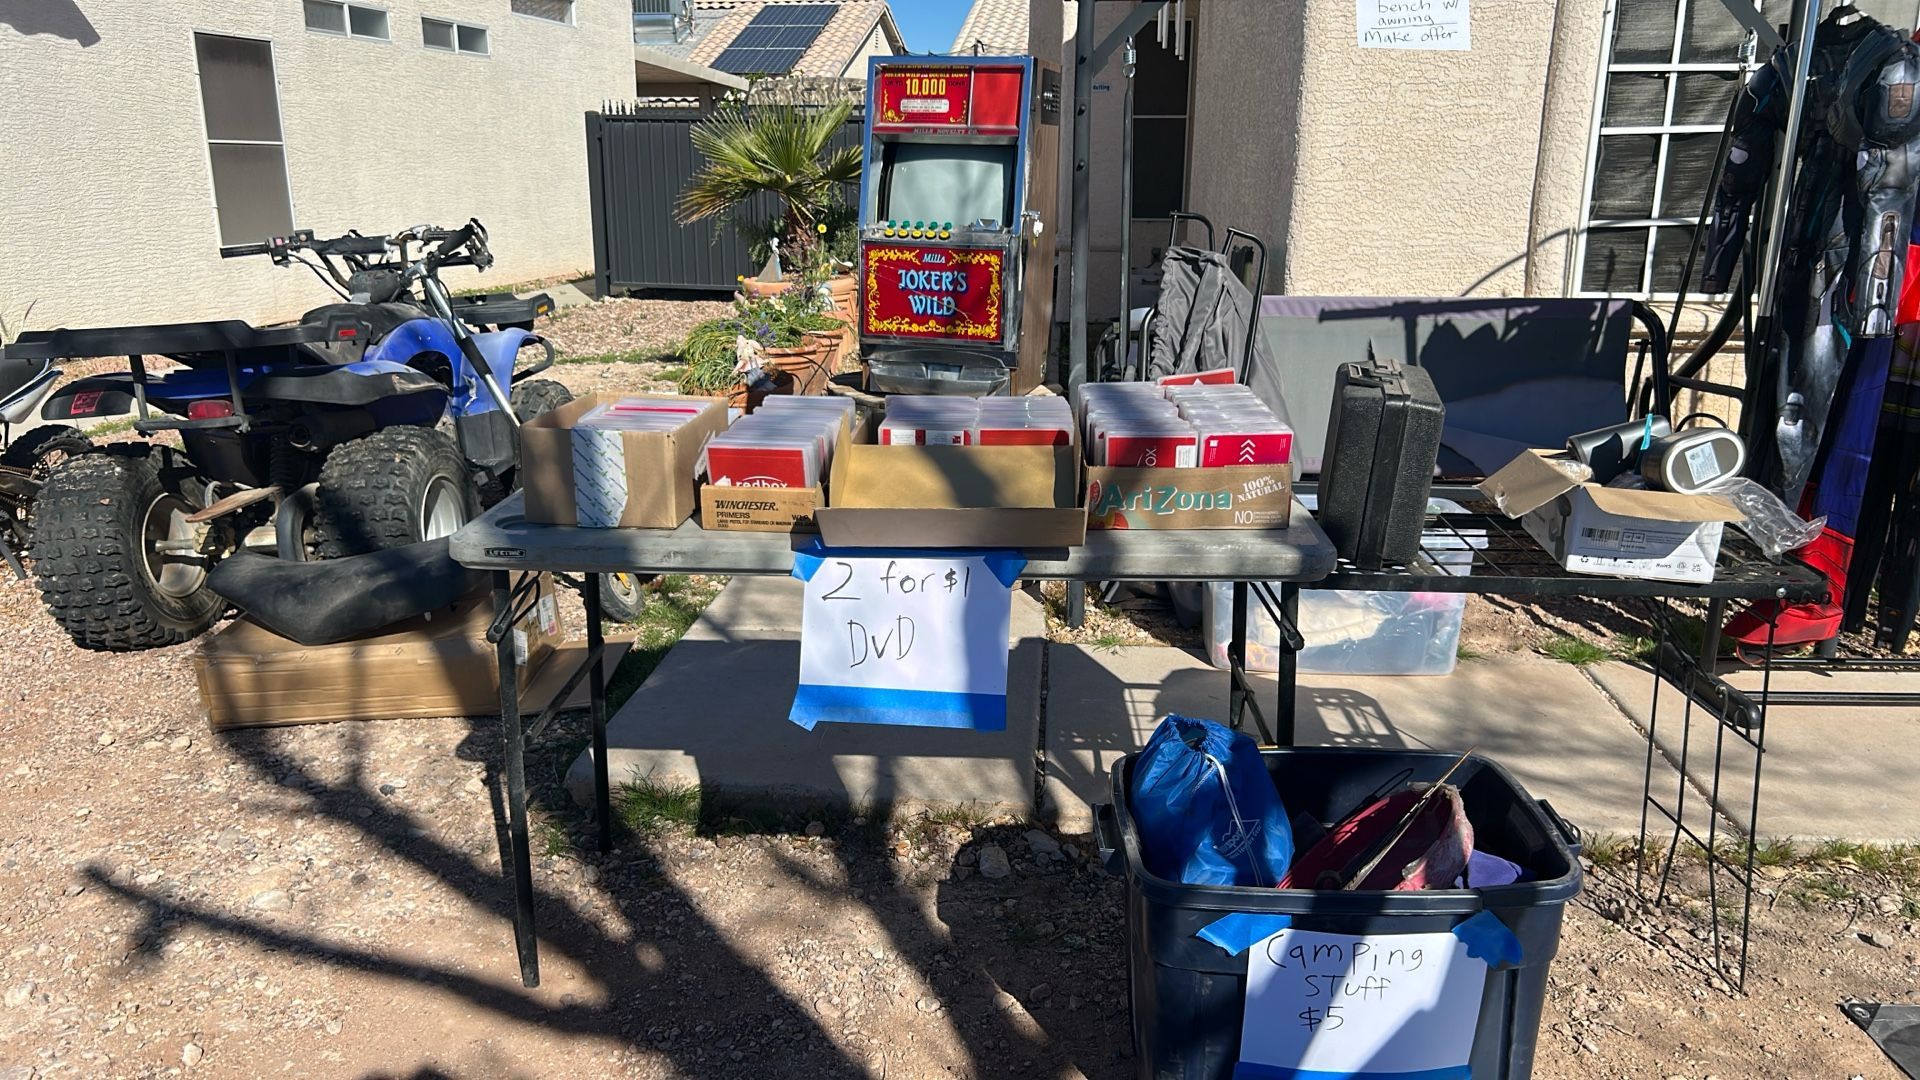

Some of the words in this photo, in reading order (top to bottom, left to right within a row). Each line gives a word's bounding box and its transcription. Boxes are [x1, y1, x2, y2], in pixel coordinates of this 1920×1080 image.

[1377, 0, 1431, 13] bench
[1378, 15, 1434, 26] awning
[1420, 25, 1458, 42] offer
[905, 78, 946, 97] 10,000
[922, 254, 945, 264] Mills
[898, 269, 967, 292] JOKER'S
[908, 294, 956, 315] WILD
[1236, 481, 1284, 503] NATURAL
[1242, 475, 1275, 493] 100%
[716, 511, 751, 519] PRIMERS
[1234, 510, 1254, 524] NO
[821, 561, 862, 601] 2
[880, 560, 936, 595] for
[943, 565, 970, 598] $1
[1266, 933, 1423, 975] Camping
[1298, 1006, 1344, 1032] $5
